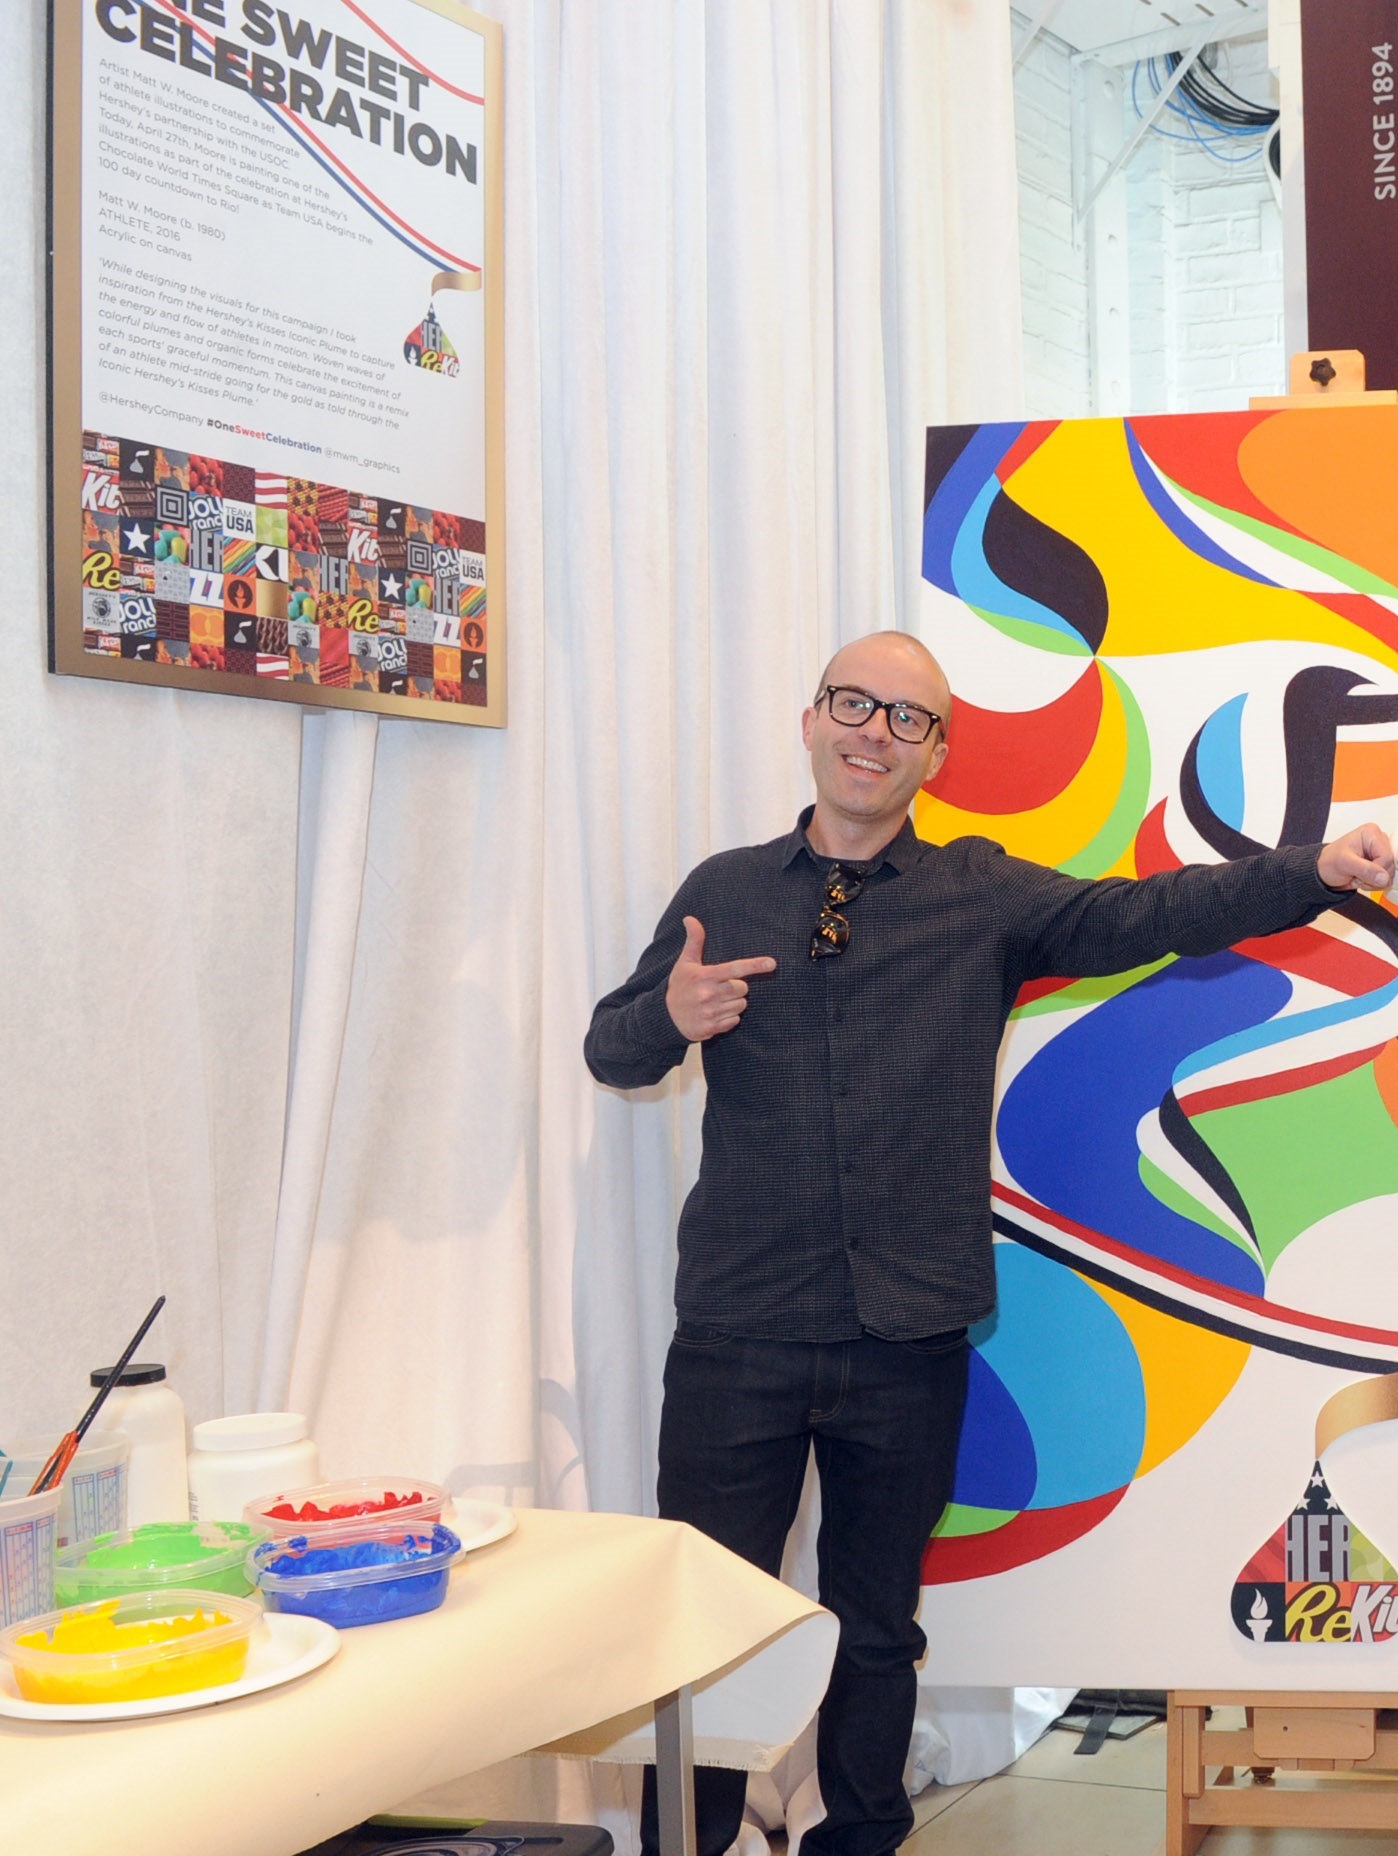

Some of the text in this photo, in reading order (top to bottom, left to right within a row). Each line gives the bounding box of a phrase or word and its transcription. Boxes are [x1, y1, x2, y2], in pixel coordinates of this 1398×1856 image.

[241, 0, 429, 112] SWEET
[95, 0, 477, 186] CELEBRATION
[98, 75, 300, 159] of athlete illustrations to commemorate
[98, 90, 151, 118] Hershey's
[153, 112, 214, 141] partnership
[216, 136, 239, 150] with
[240, 144, 257, 158] the
[99, 58, 129, 77] Artist
[132, 70, 157, 88] Matt
[176, 87, 209, 108] Moore
[211, 103, 250, 124] created
[251, 118, 259, 127] a
[260, 122, 275, 134] set
[1371, 42, 1396, 200] SINCE 1894
[98, 106, 133, 129] Today,
[136, 121, 162, 138] April
[193, 141, 227, 162] Moore
[239, 160, 280, 183] painting
[281, 176, 300, 189] one
[302, 184, 312, 193] of
[314, 187, 330, 200] the
[98, 124, 348, 222] illustrations as part of the celebration at Hershey's
[98, 156, 119, 172] 100
[121, 165, 142, 181] day
[144, 174, 204, 201] countdown
[206, 194, 218, 206] to
[98, 140, 373, 245] Chocolate World Times Square as Team USA begins the
[98, 189, 124, 207] Matt
[143, 204, 177, 225] Moore
[197, 222, 226, 241] 1980)
[98, 207, 181, 242] ATHLETE, 2016
[98, 224, 192, 262] Acrylic on canvas
[98, 274, 395, 370] inspiration from the Hershey's Kisses Iconic Plume to capture
[98, 291, 117, 304] the
[118, 298, 158, 317] energy
[159, 309, 181, 322] and
[182, 314, 205, 329] flow
[206, 323, 219, 332] of
[219, 327, 260, 345] athletes
[262, 338, 272, 348] in
[312, 352, 344, 369] Woven
[346, 365, 373, 378] waves
[375, 372, 386, 381] of
[135, 269, 187, 294] designing
[189, 285, 207, 298] the
[209, 292, 243, 309] visuals
[245, 301, 261, 313] for
[262, 307, 280, 320] this
[281, 314, 328, 335] campaign
[335, 330, 356, 343] took
[97, 308, 401, 400] colorful plumes and organic forms celebrate the excitement of
[98, 325, 125, 339] each
[166, 344, 210, 362] graceful
[274, 371, 293, 386] This
[295, 380, 327, 395] canvas
[328, 389, 367, 407] painting
[377, 403, 383, 411] a
[98, 357, 132, 375] Iconic
[133, 366, 185, 389] Hershey's
[187, 380, 219, 397] Kisses
[98, 341, 400, 430] of an athlete mid-stride going for the gold as told through the
[99, 391, 204, 427] @HersheyCompany
[206, 417, 322, 455] #OneSweetCelebration
[82, 471, 121, 512] Kit
[226, 506, 252, 518] TEAM
[226, 515, 254, 534] USA
[348, 528, 379, 565] Kit
[462, 556, 483, 567] TEAM
[463, 566, 485, 582] USA
[1285, 1584, 1351, 1642] Re
